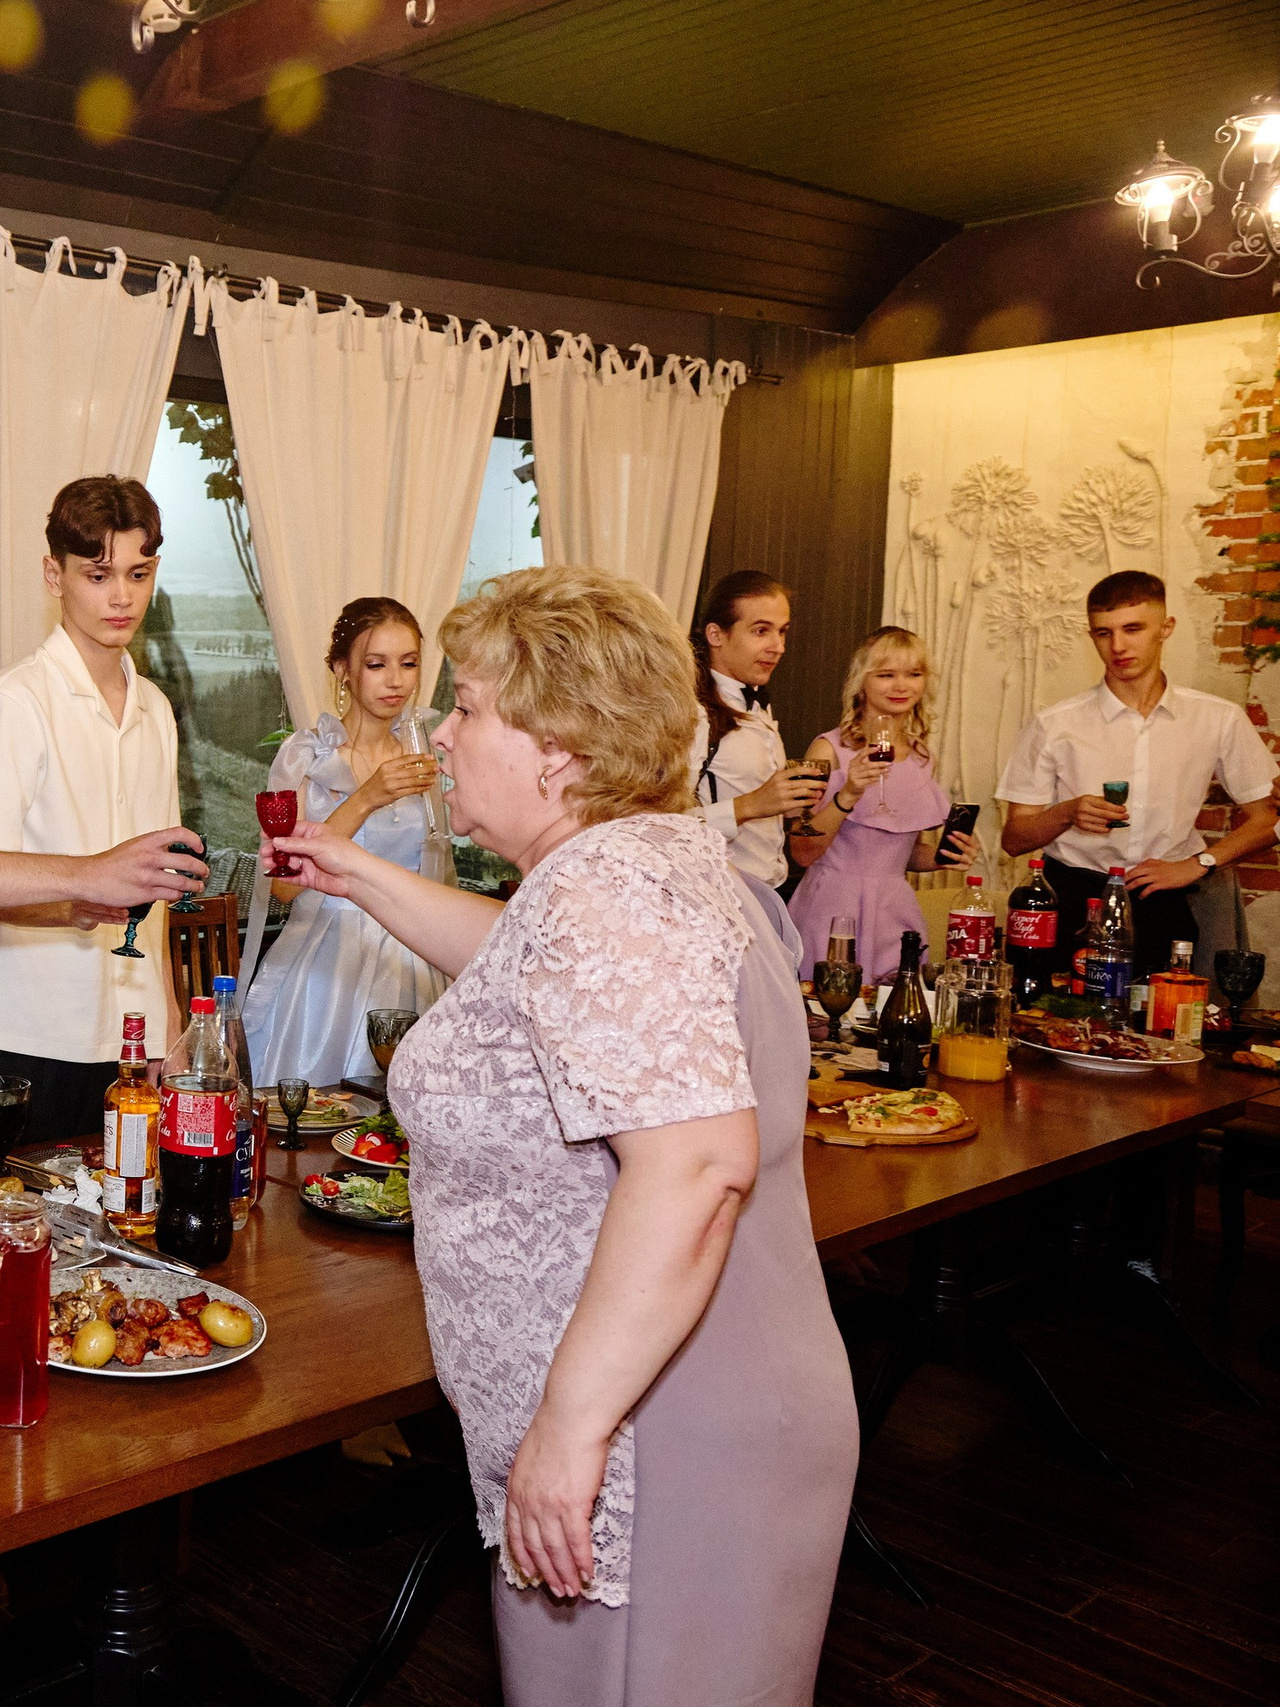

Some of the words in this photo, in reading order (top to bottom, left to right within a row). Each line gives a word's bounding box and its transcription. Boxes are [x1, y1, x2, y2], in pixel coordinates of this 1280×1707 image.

[1010, 912, 1042, 925] Export
[947, 928, 969, 940] ОЛА
[1012, 921, 1035, 934] Style
